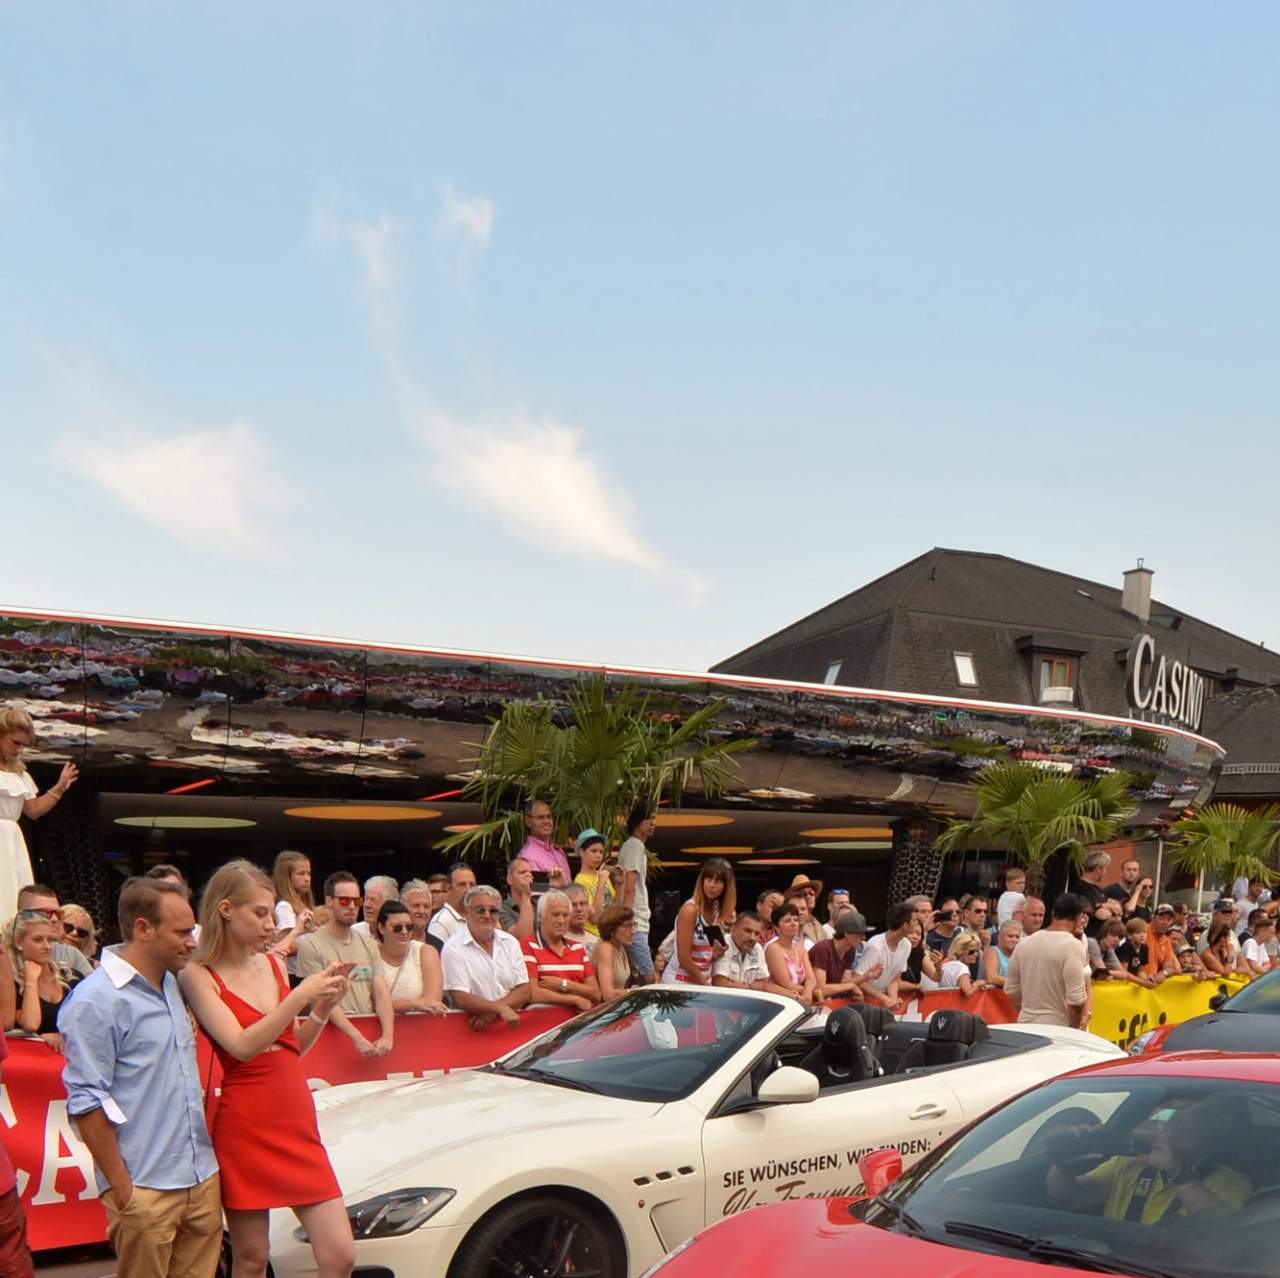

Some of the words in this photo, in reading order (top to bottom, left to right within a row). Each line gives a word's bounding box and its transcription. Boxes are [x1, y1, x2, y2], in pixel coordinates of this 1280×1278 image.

[1133, 633, 1204, 731] CASINO
[723, 1169, 745, 1189] SIE
[750, 1154, 843, 1183] WÜNSCHEN,
